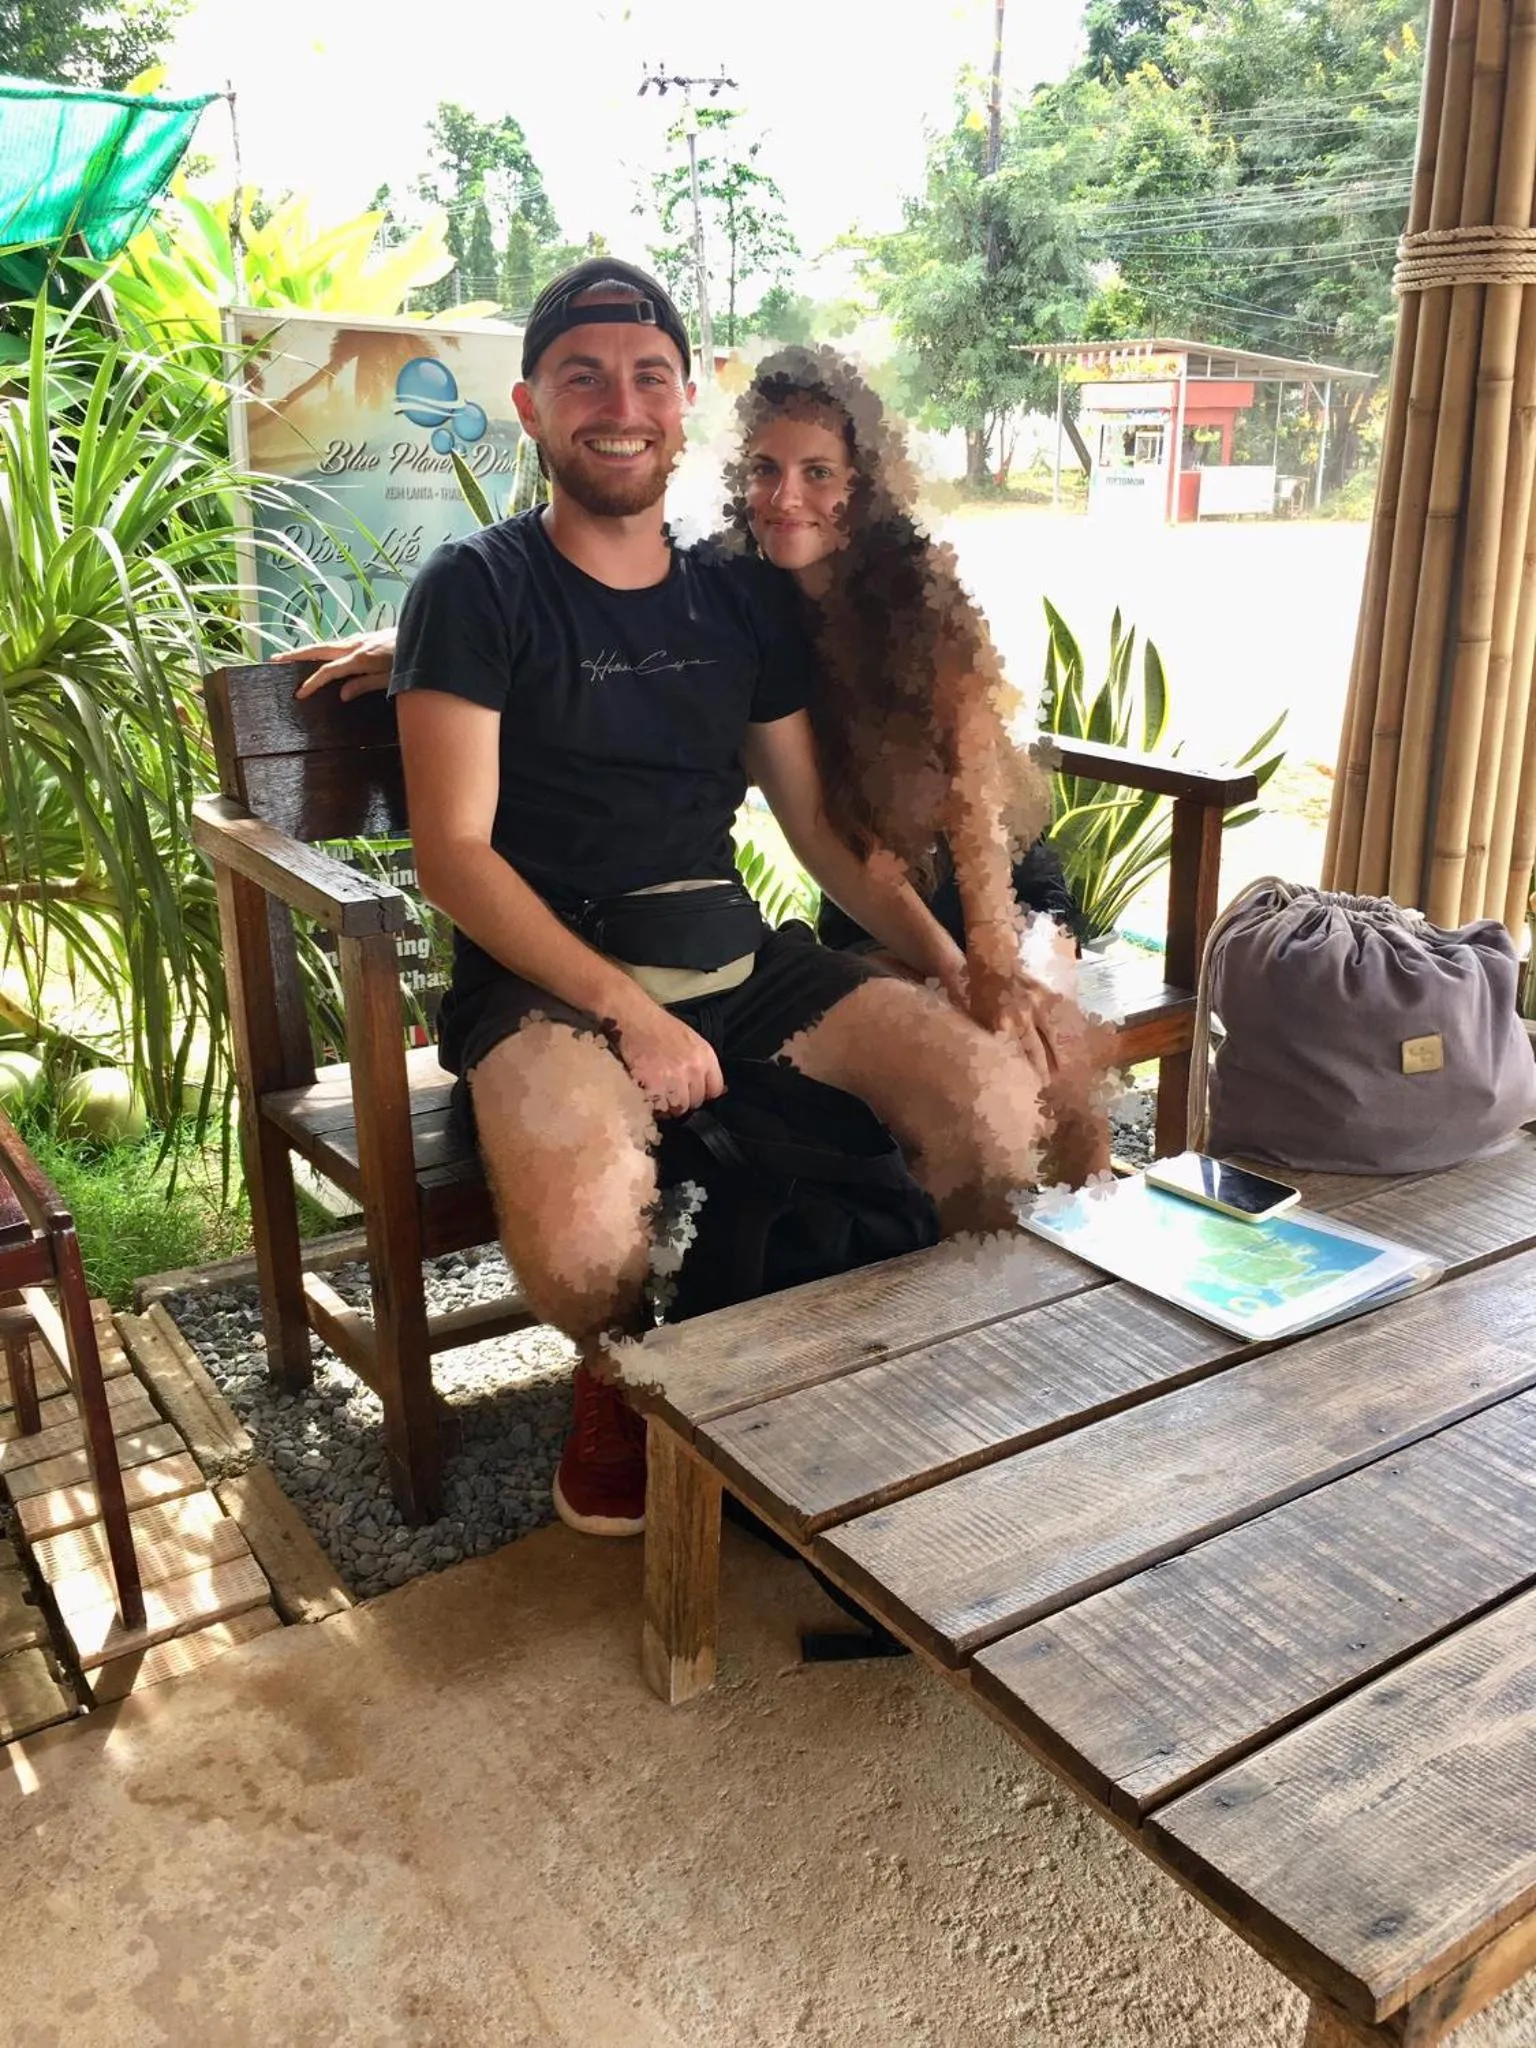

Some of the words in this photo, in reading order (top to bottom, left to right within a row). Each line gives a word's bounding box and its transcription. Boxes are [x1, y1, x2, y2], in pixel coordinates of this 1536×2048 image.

[318, 440, 381, 476] Blue
[389, 442, 455, 476] Plane
[266, 523, 351, 570] Dive
